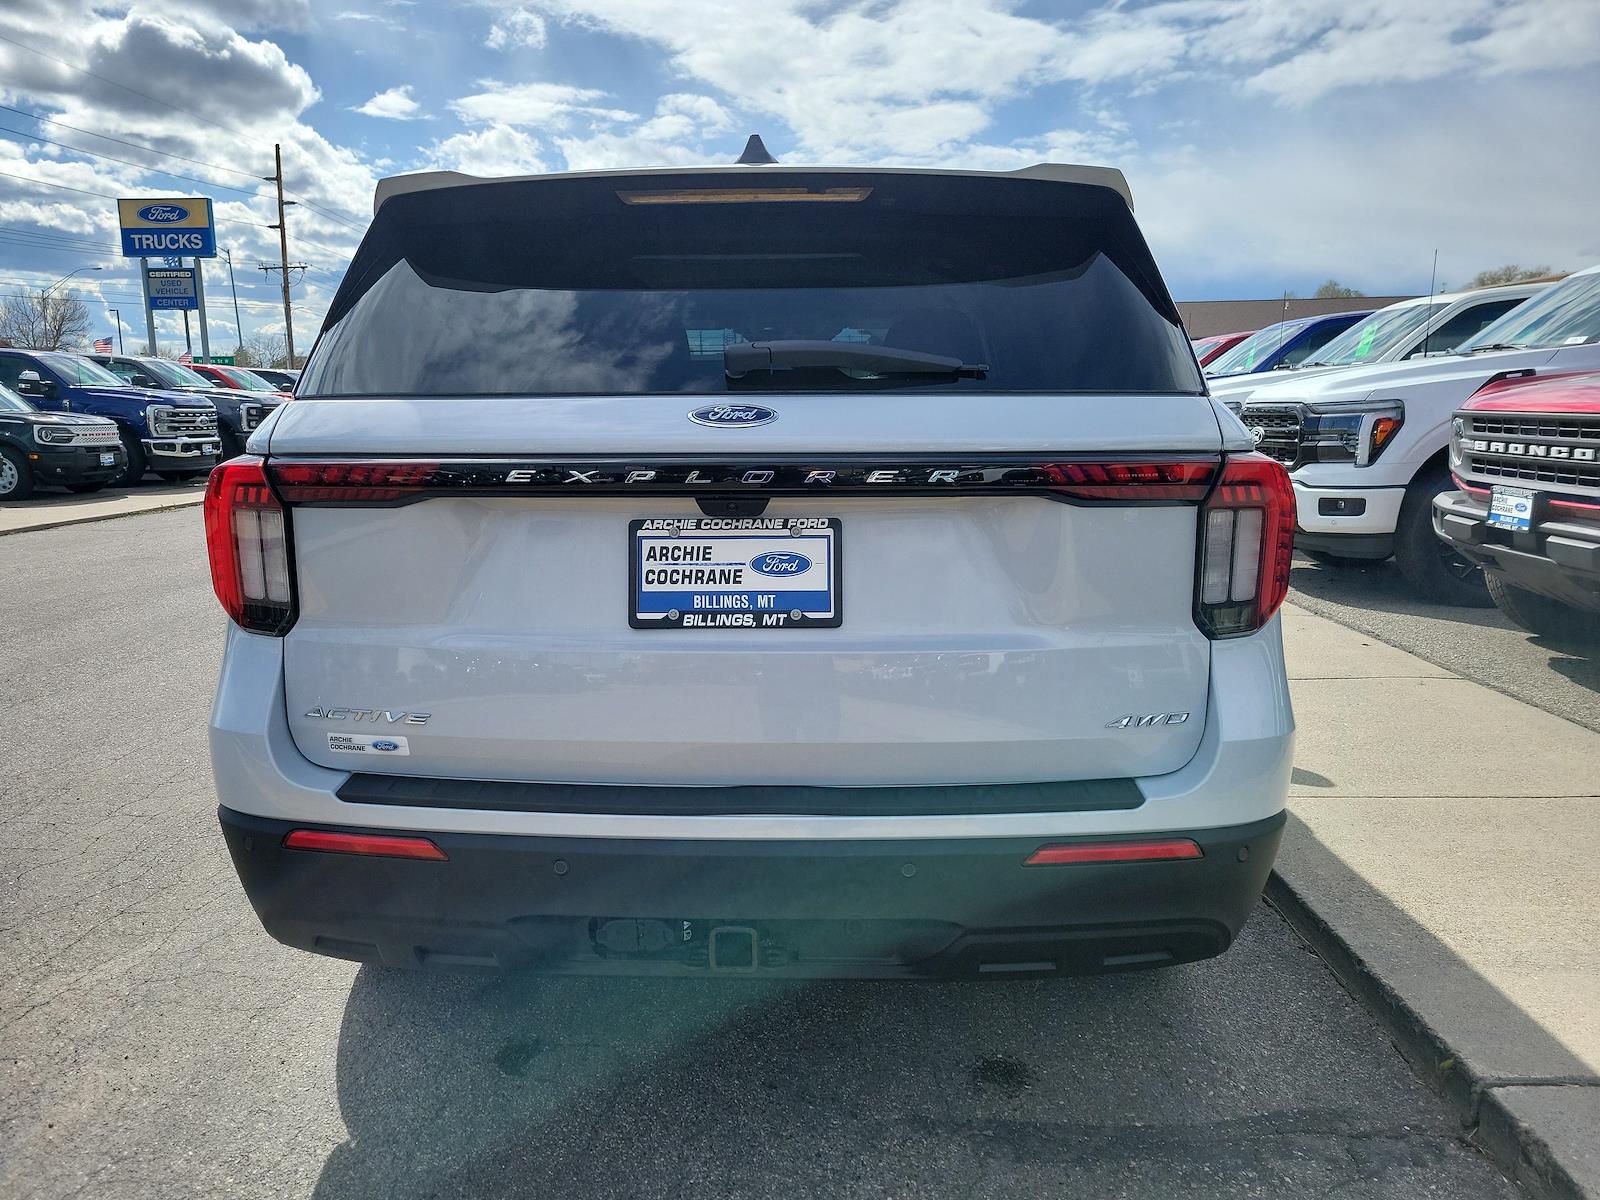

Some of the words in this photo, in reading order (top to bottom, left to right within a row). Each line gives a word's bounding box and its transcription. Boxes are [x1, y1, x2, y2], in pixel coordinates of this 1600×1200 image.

[147, 206, 180, 221] Ford
[130, 233, 203, 250] TRUCKS
[155, 287, 189, 295] VEHICLE
[160, 279, 182, 287] USED
[708, 405, 757, 422] Ford
[1473, 440, 1596, 460] BRONCO
[505, 469, 960, 484] EXPLORER
[642, 518, 697, 530] ARCHIE
[700, 518, 783, 530] COCHRANE
[787, 518, 829, 530] FORD
[645, 545, 713, 562] ARCHIE
[762, 553, 799, 573] Ford
[645, 569, 743, 585] COCHRANE
[693, 594, 753, 610] BILLINGS,
[757, 594, 776, 608] MT
[682, 613, 757, 627] BILLINGS,
[762, 613, 787, 626] MT
[304, 706, 432, 725] ACTIVE
[1104, 712, 1190, 729] 4WD
[330, 743, 366, 752] COCHRANE
